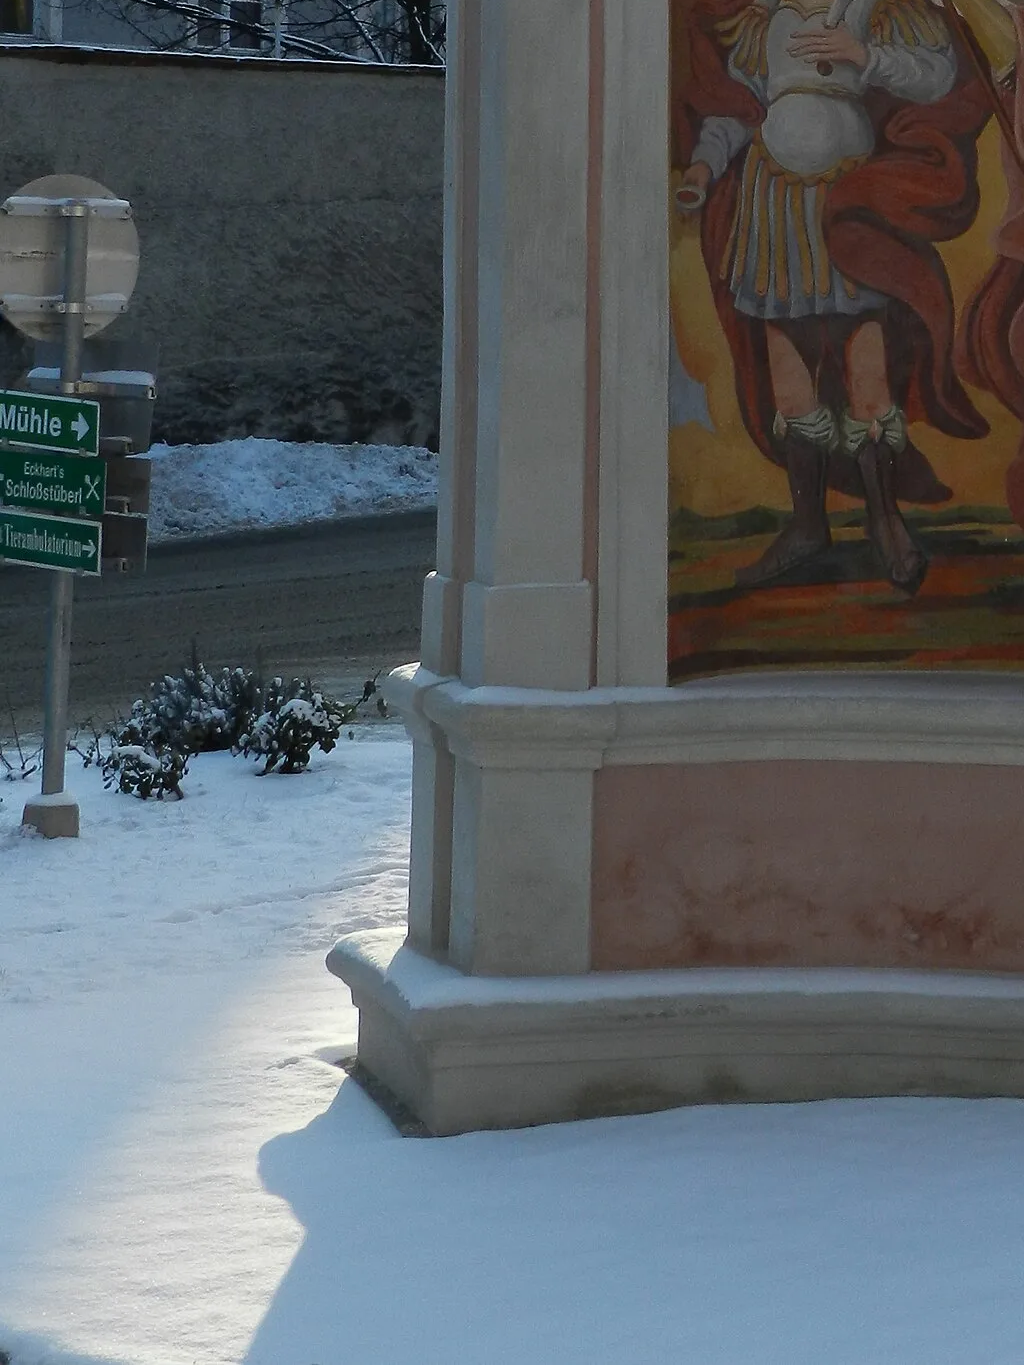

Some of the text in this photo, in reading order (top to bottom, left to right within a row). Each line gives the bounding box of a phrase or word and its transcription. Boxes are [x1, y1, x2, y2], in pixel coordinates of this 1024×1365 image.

[0, 403, 62, 437] Mühle
[5, 478, 82, 504] Schloßstüberl
[4, 523, 82, 558] Tierambulatorium
